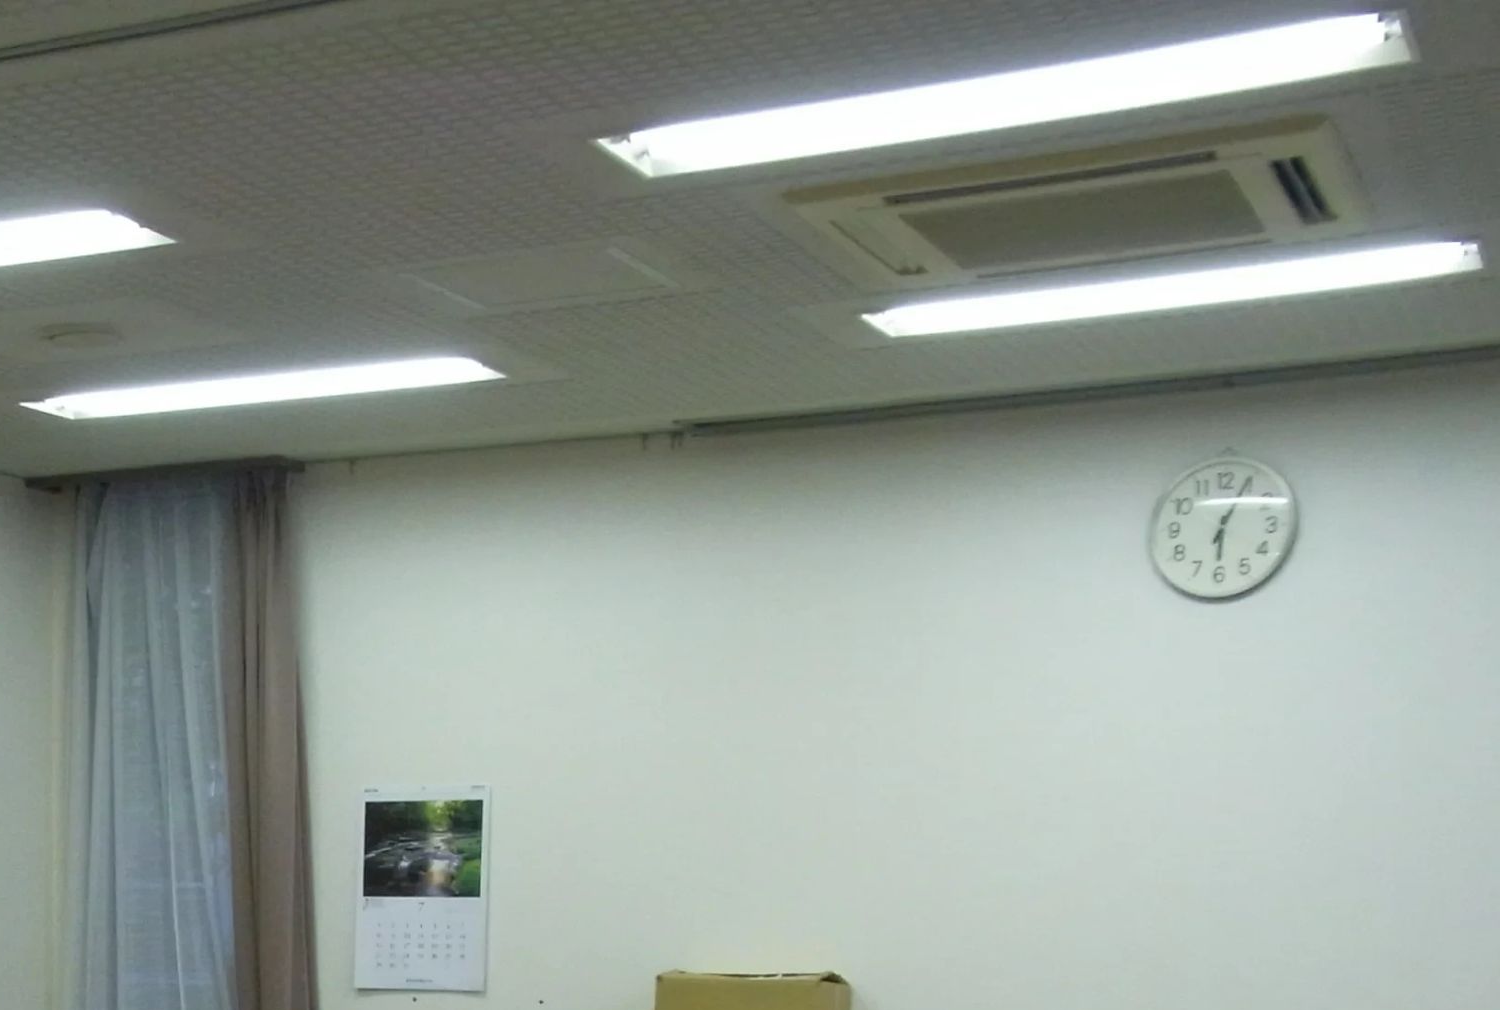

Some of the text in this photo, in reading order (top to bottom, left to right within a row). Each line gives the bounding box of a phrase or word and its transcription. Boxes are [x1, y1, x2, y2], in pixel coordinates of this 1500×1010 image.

[1195, 479, 1210, 497] 11
[1216, 471, 1235, 490] 12
[1171, 497, 1194, 516] 10
[1167, 521, 1181, 539] 9
[1265, 515, 1278, 534] 3
[1173, 544, 1186, 562] 8
[1256, 540, 1269, 555] 4
[1191, 560, 1203, 578] 7
[1213, 565, 1226, 583] 6
[1238, 557, 1252, 576] 5
